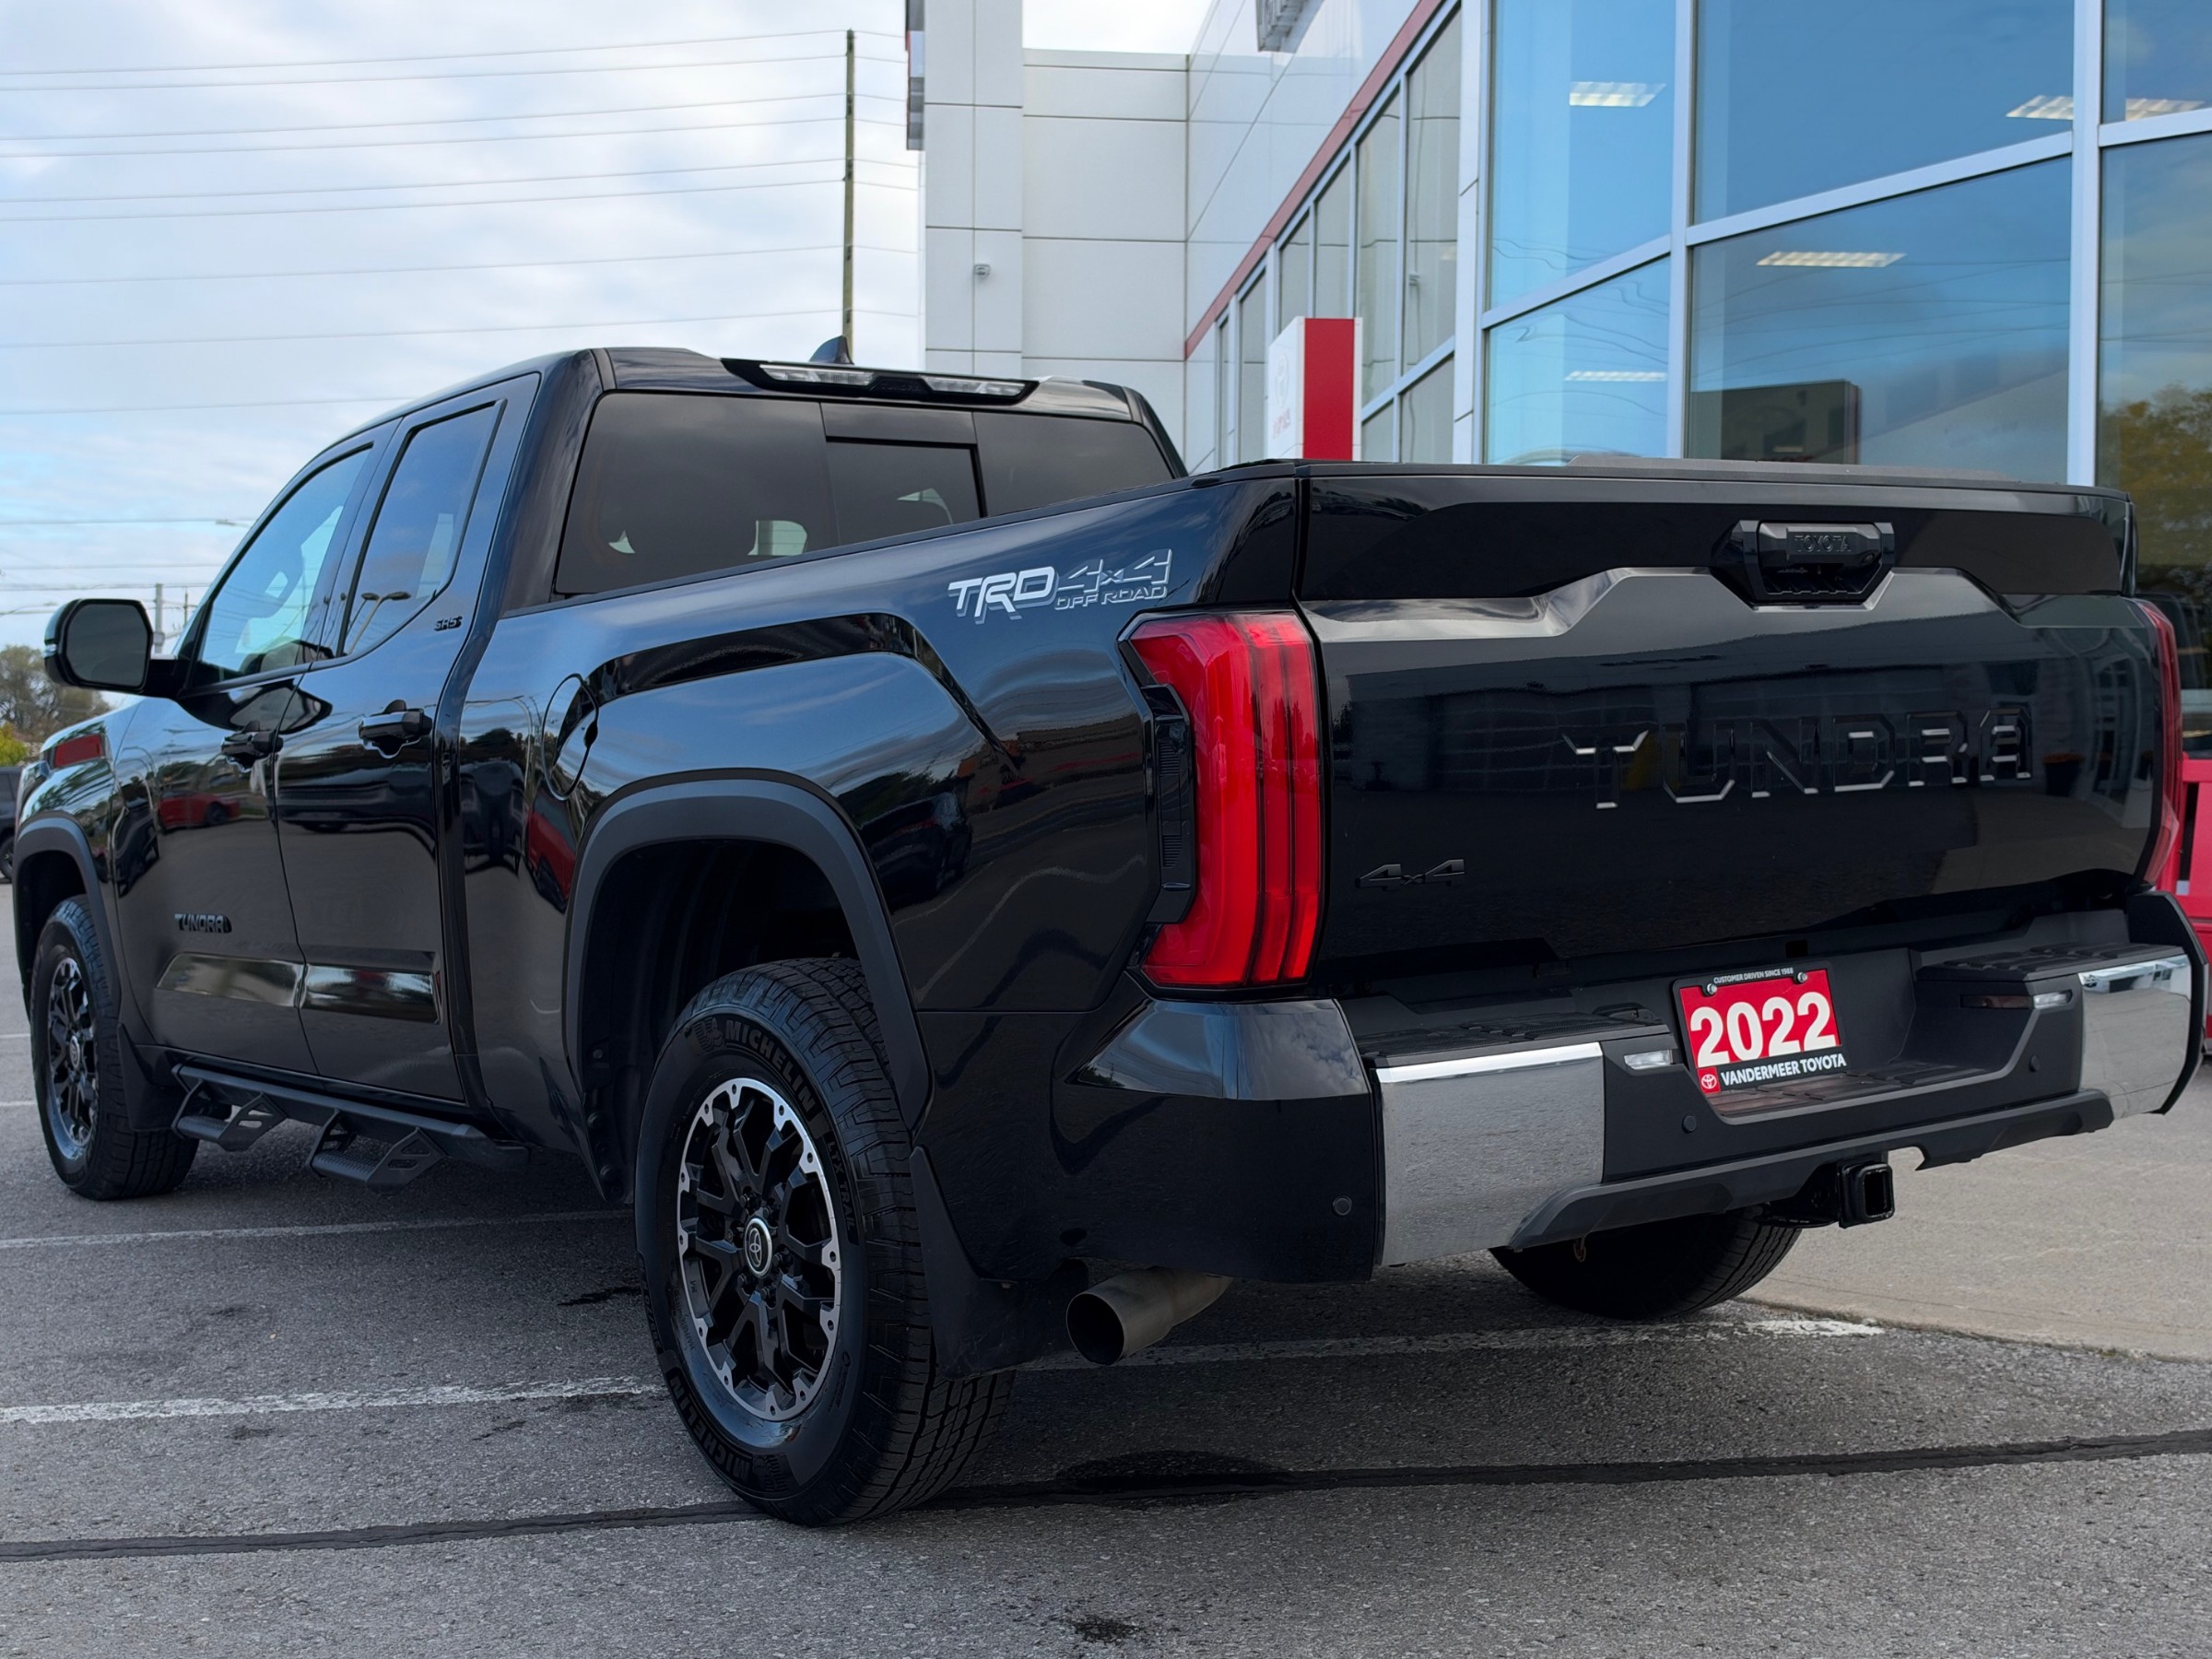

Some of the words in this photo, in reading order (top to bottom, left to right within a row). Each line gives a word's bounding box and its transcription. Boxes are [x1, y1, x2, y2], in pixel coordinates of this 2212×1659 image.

[1794, 535, 1852, 553] TOYOTA
[947, 566, 1058, 624] TRD
[1054, 594, 1099, 610] OFF
[1100, 585, 1168, 606] ROAD
[1562, 707, 2031, 809] TUNDRA
[174, 913, 231, 934] TUNDRA
[1713, 973, 1743, 983] CUSTOMER
[1744, 971, 1764, 979] DRIVEN
[1764, 968, 1781, 976] SINCE
[1689, 992, 1836, 1067] 2022
[725, 1020, 817, 1112] MICHELIN
[1721, 1061, 1800, 1086] VANDERMEER
[1799, 1053, 1847, 1074] TOYOTA
[828, 1141, 844, 1174] LTX
[840, 1181, 856, 1231] TRAIL
[668, 1373, 753, 1477] MICHELIN
